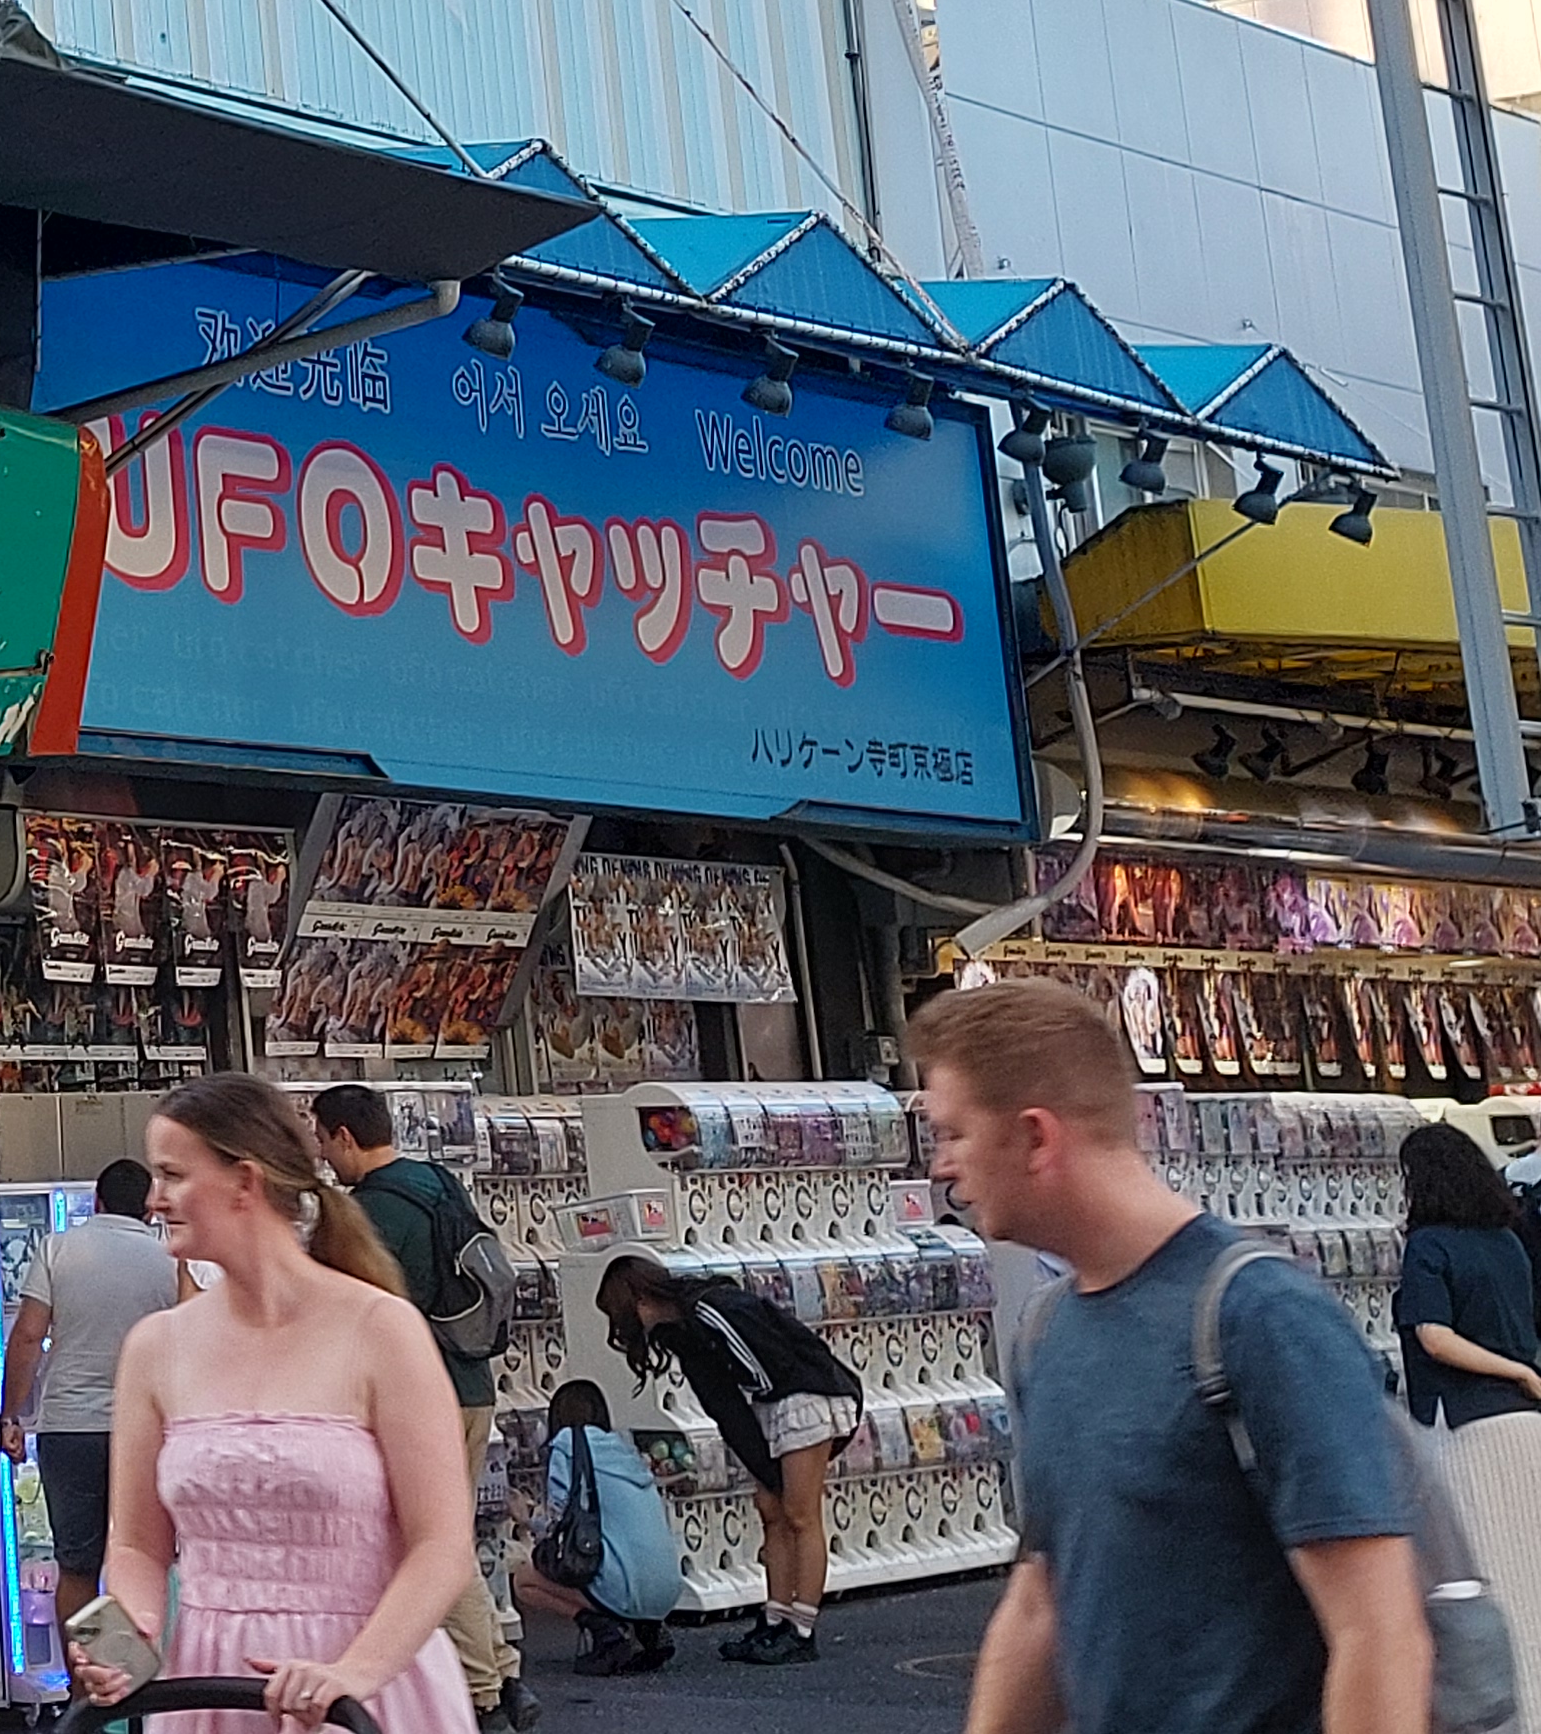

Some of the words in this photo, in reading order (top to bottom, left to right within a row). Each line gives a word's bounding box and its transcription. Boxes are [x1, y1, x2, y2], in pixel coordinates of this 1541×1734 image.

[452, 358, 525, 439] 어서
[540, 380, 649, 457] 오세요
[693, 408, 865, 496] Welcome
[89, 409, 964, 688] UFOキャッチャー
[751, 728, 974, 786] ハリケーン寺町京極店
